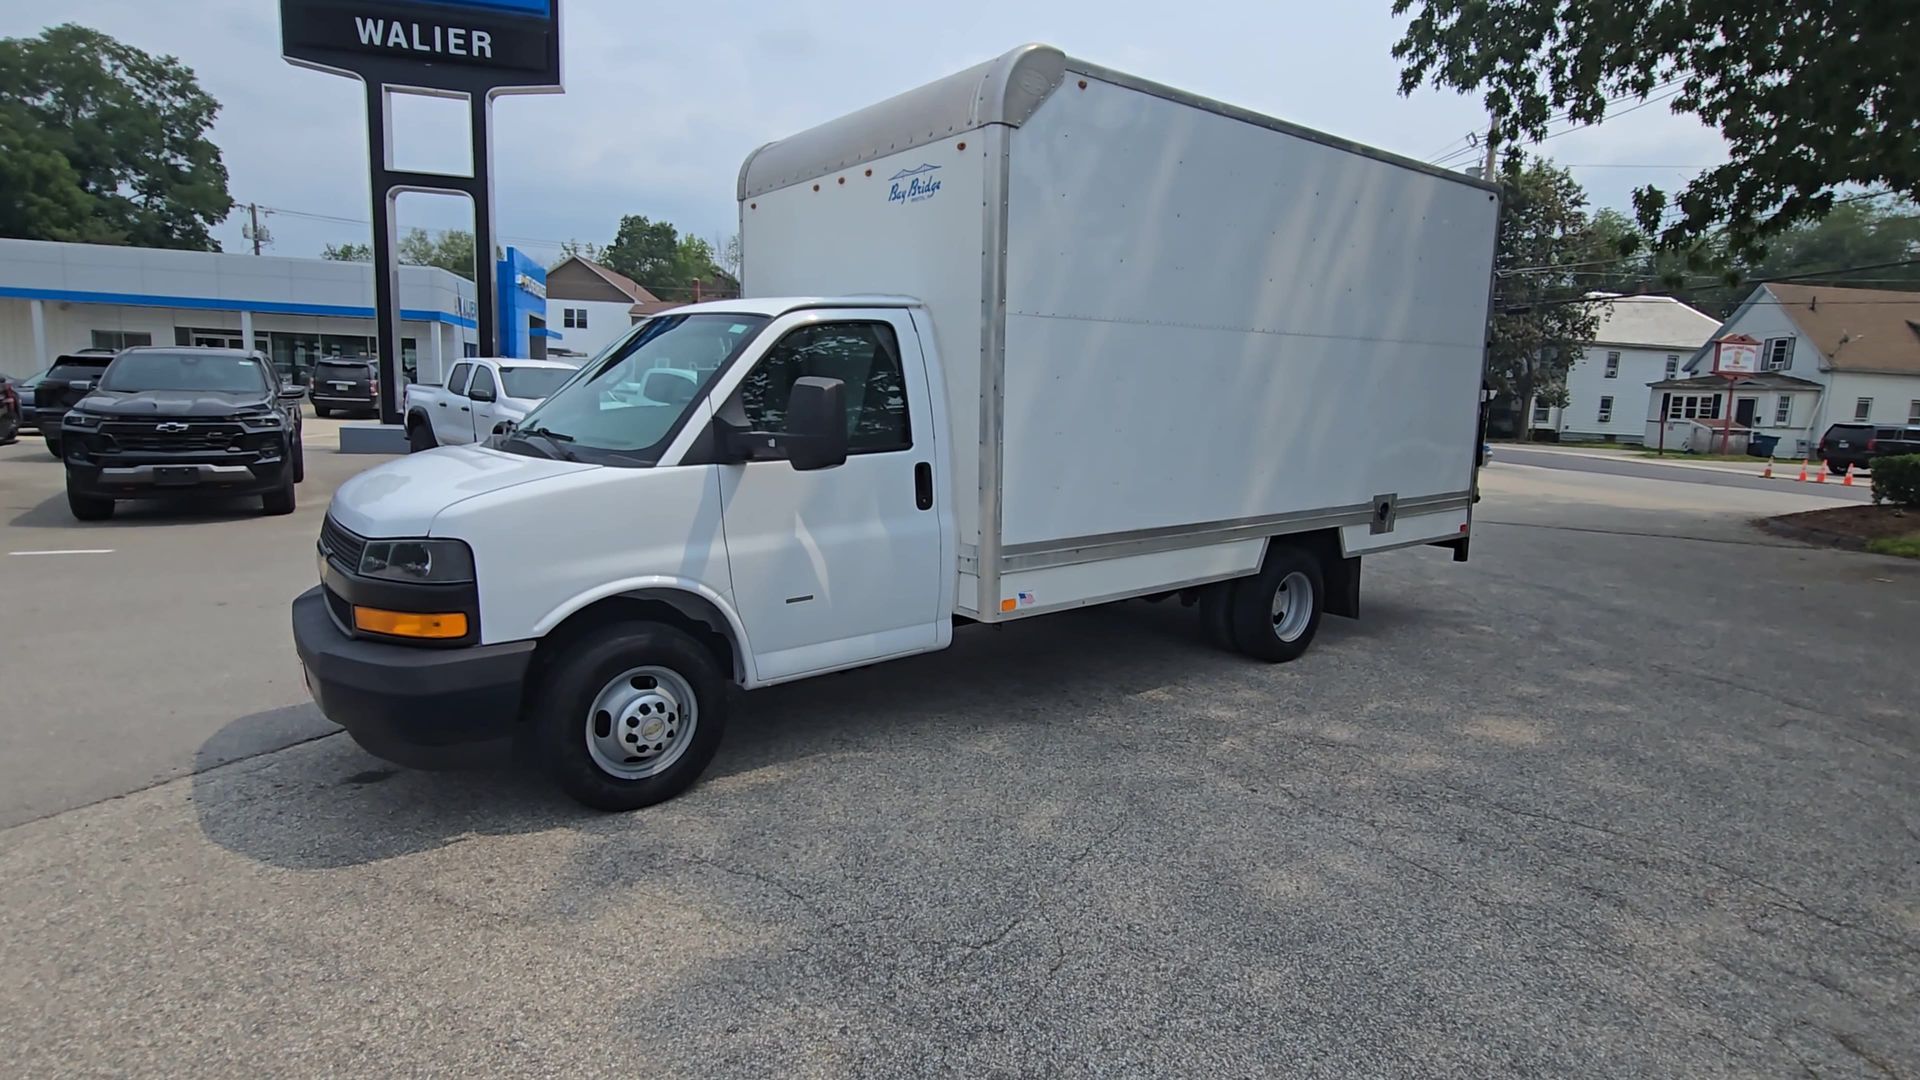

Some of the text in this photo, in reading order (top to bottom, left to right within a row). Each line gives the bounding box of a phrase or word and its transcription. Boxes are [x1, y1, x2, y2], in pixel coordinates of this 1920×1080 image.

[355, 16, 492, 58] WALIER
[888, 175, 941, 205] Bay Bridge
